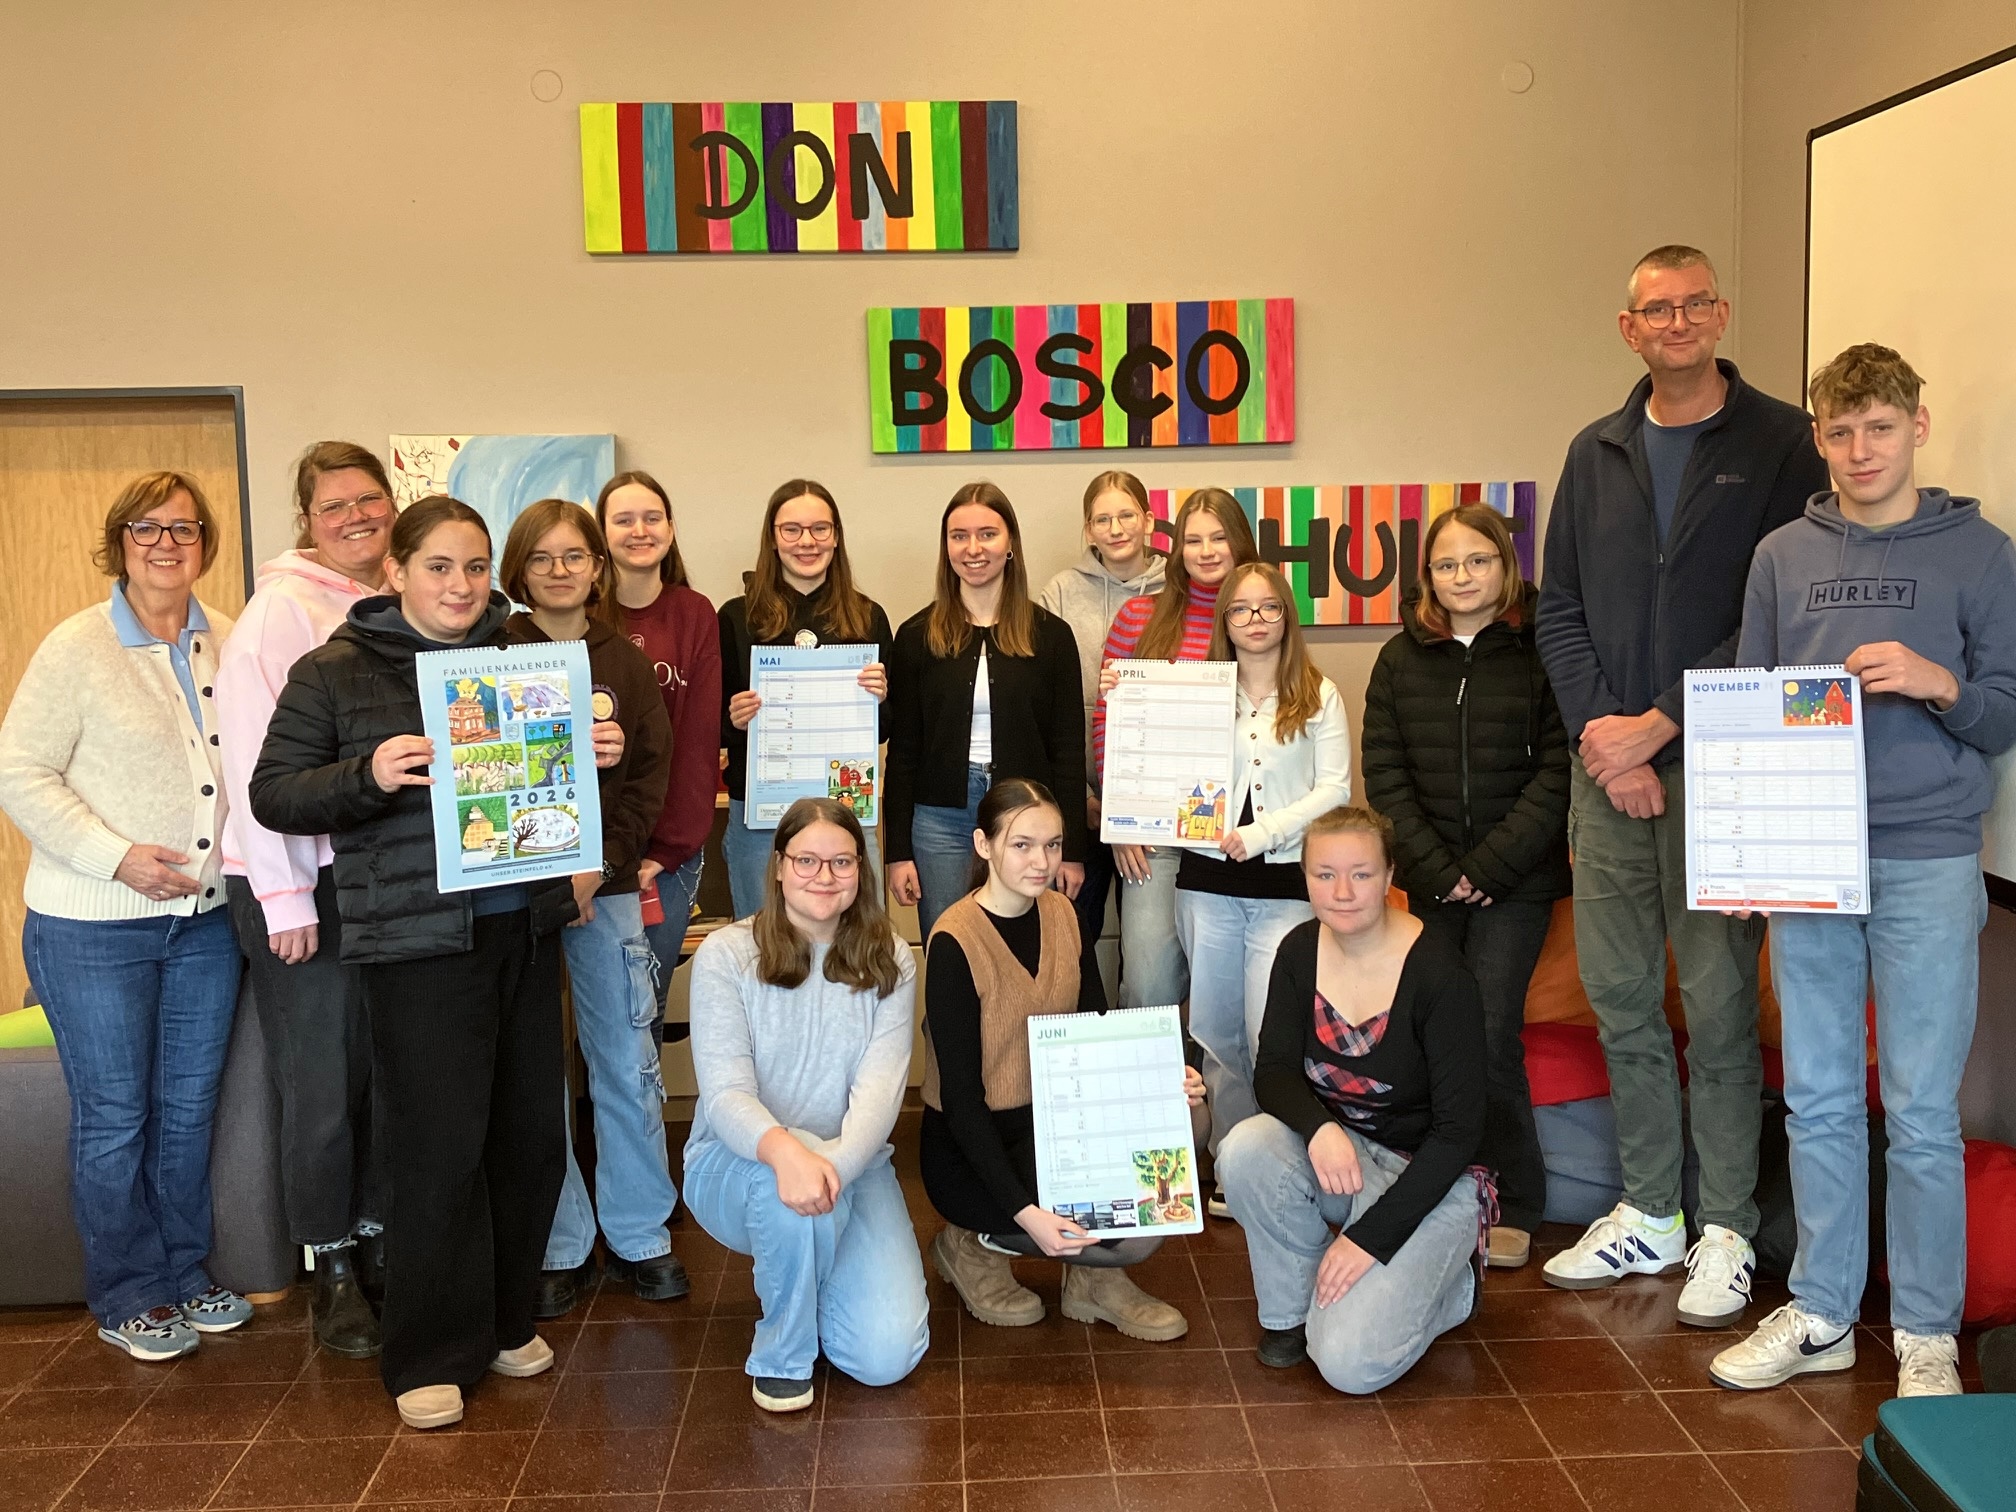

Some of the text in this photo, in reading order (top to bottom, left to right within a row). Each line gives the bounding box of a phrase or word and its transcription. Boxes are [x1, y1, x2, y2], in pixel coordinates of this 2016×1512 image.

[688, 130, 914, 221] DON
[888, 329, 1251, 426] BOSCO
[1814, 585, 1908, 604] HURLEY
[443, 660, 568, 677] FAMILIENKALENDER
[759, 657, 781, 666] MAI
[1116, 669, 1146, 679] APRIL
[1692, 682, 1760, 692] NOVEMBER
[510, 787, 576, 807] 2026
[512, 865, 544, 875] STEINFELD
[1037, 1027, 1067, 1040] JUNI
